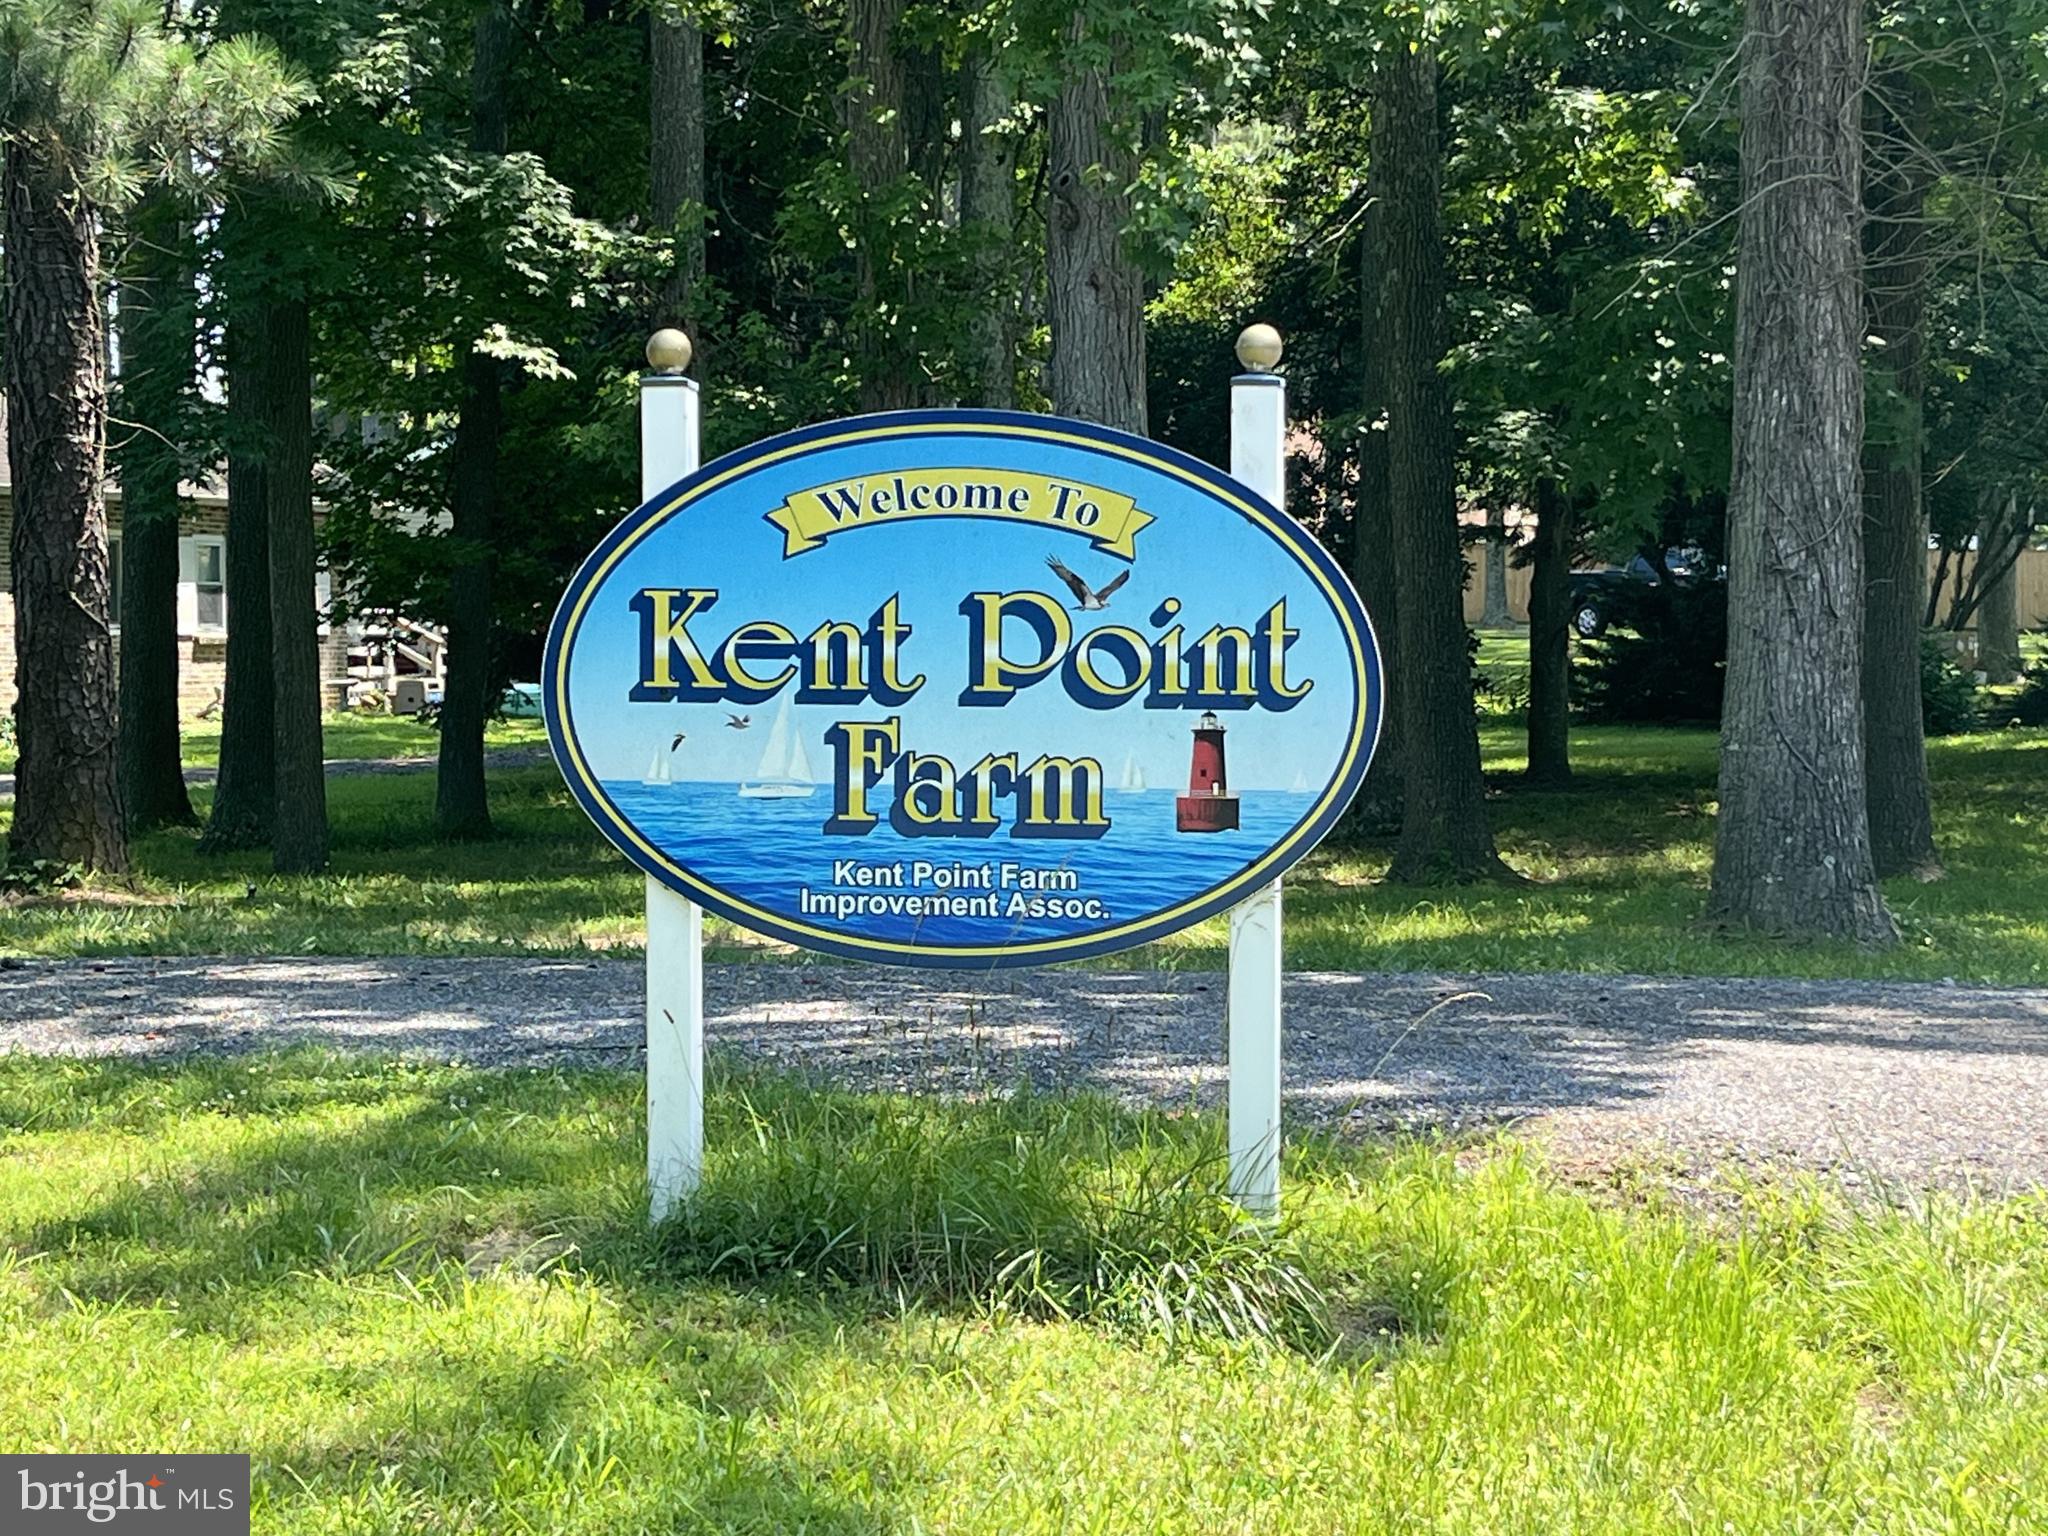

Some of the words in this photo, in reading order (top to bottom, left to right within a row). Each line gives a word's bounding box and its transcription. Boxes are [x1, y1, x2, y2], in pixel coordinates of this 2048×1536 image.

[817, 478, 1030, 523] Welcome
[1047, 483, 1100, 527] To
[630, 588, 926, 706] Kent
[959, 592, 1313, 711] Point
[823, 715, 1111, 839] Farm
[833, 861, 903, 887] Kent
[912, 863, 993, 888] Point
[1000, 864, 1077, 890] Farm
[800, 888, 999, 919] Improvement
[1004, 893, 1111, 919] Assoc.
